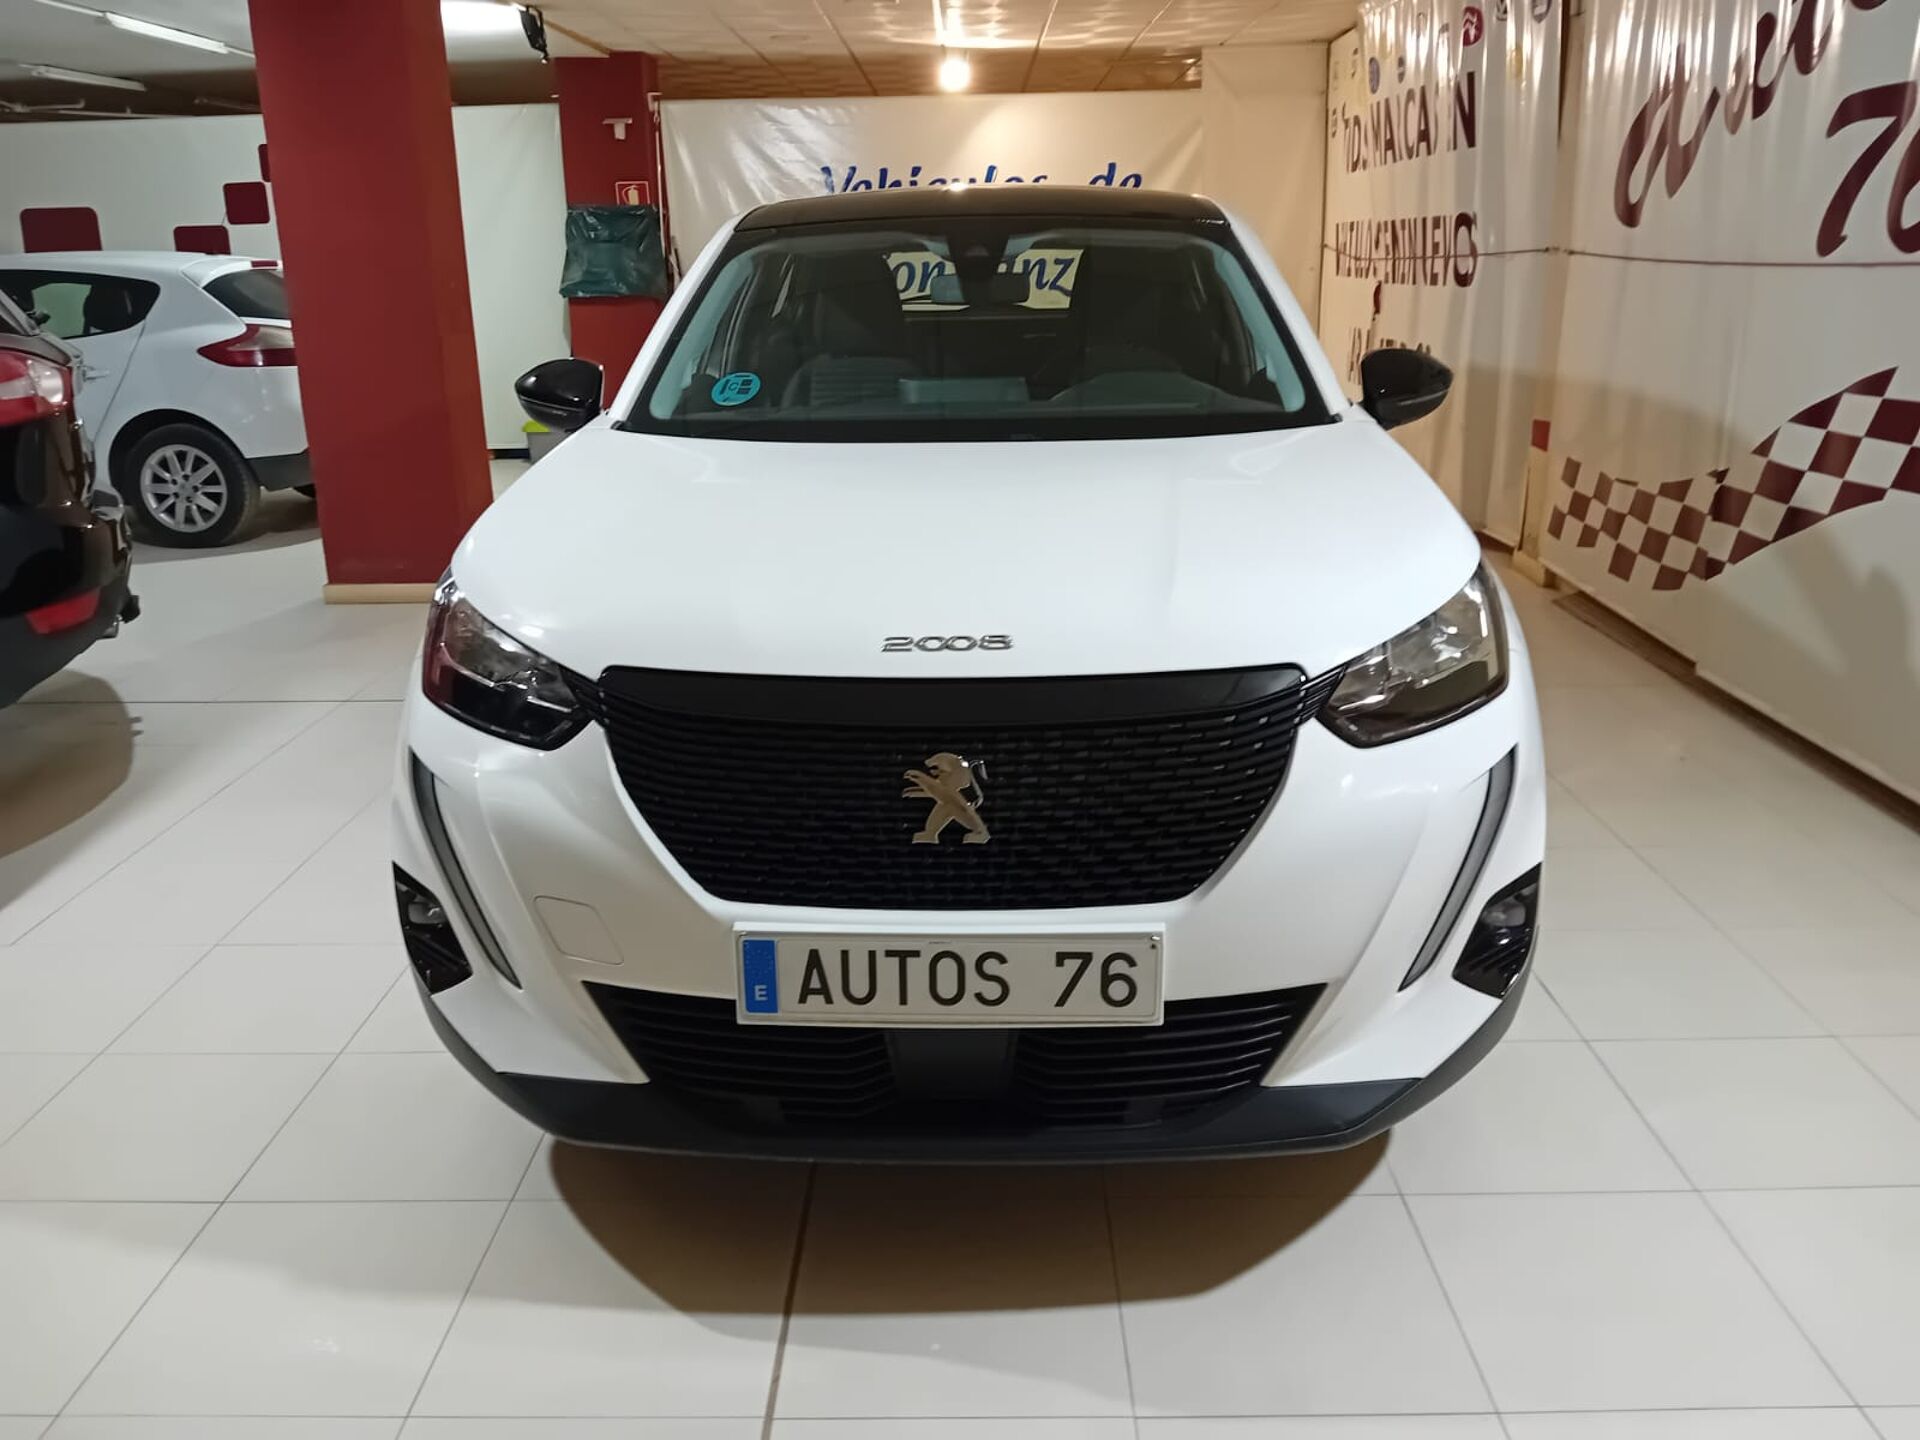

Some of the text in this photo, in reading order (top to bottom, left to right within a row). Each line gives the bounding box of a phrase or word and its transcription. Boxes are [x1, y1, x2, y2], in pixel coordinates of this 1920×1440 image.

[881, 635, 1013, 652] 2008
[797, 948, 1138, 1007] AUTOS 76
[754, 984, 768, 1001] E
